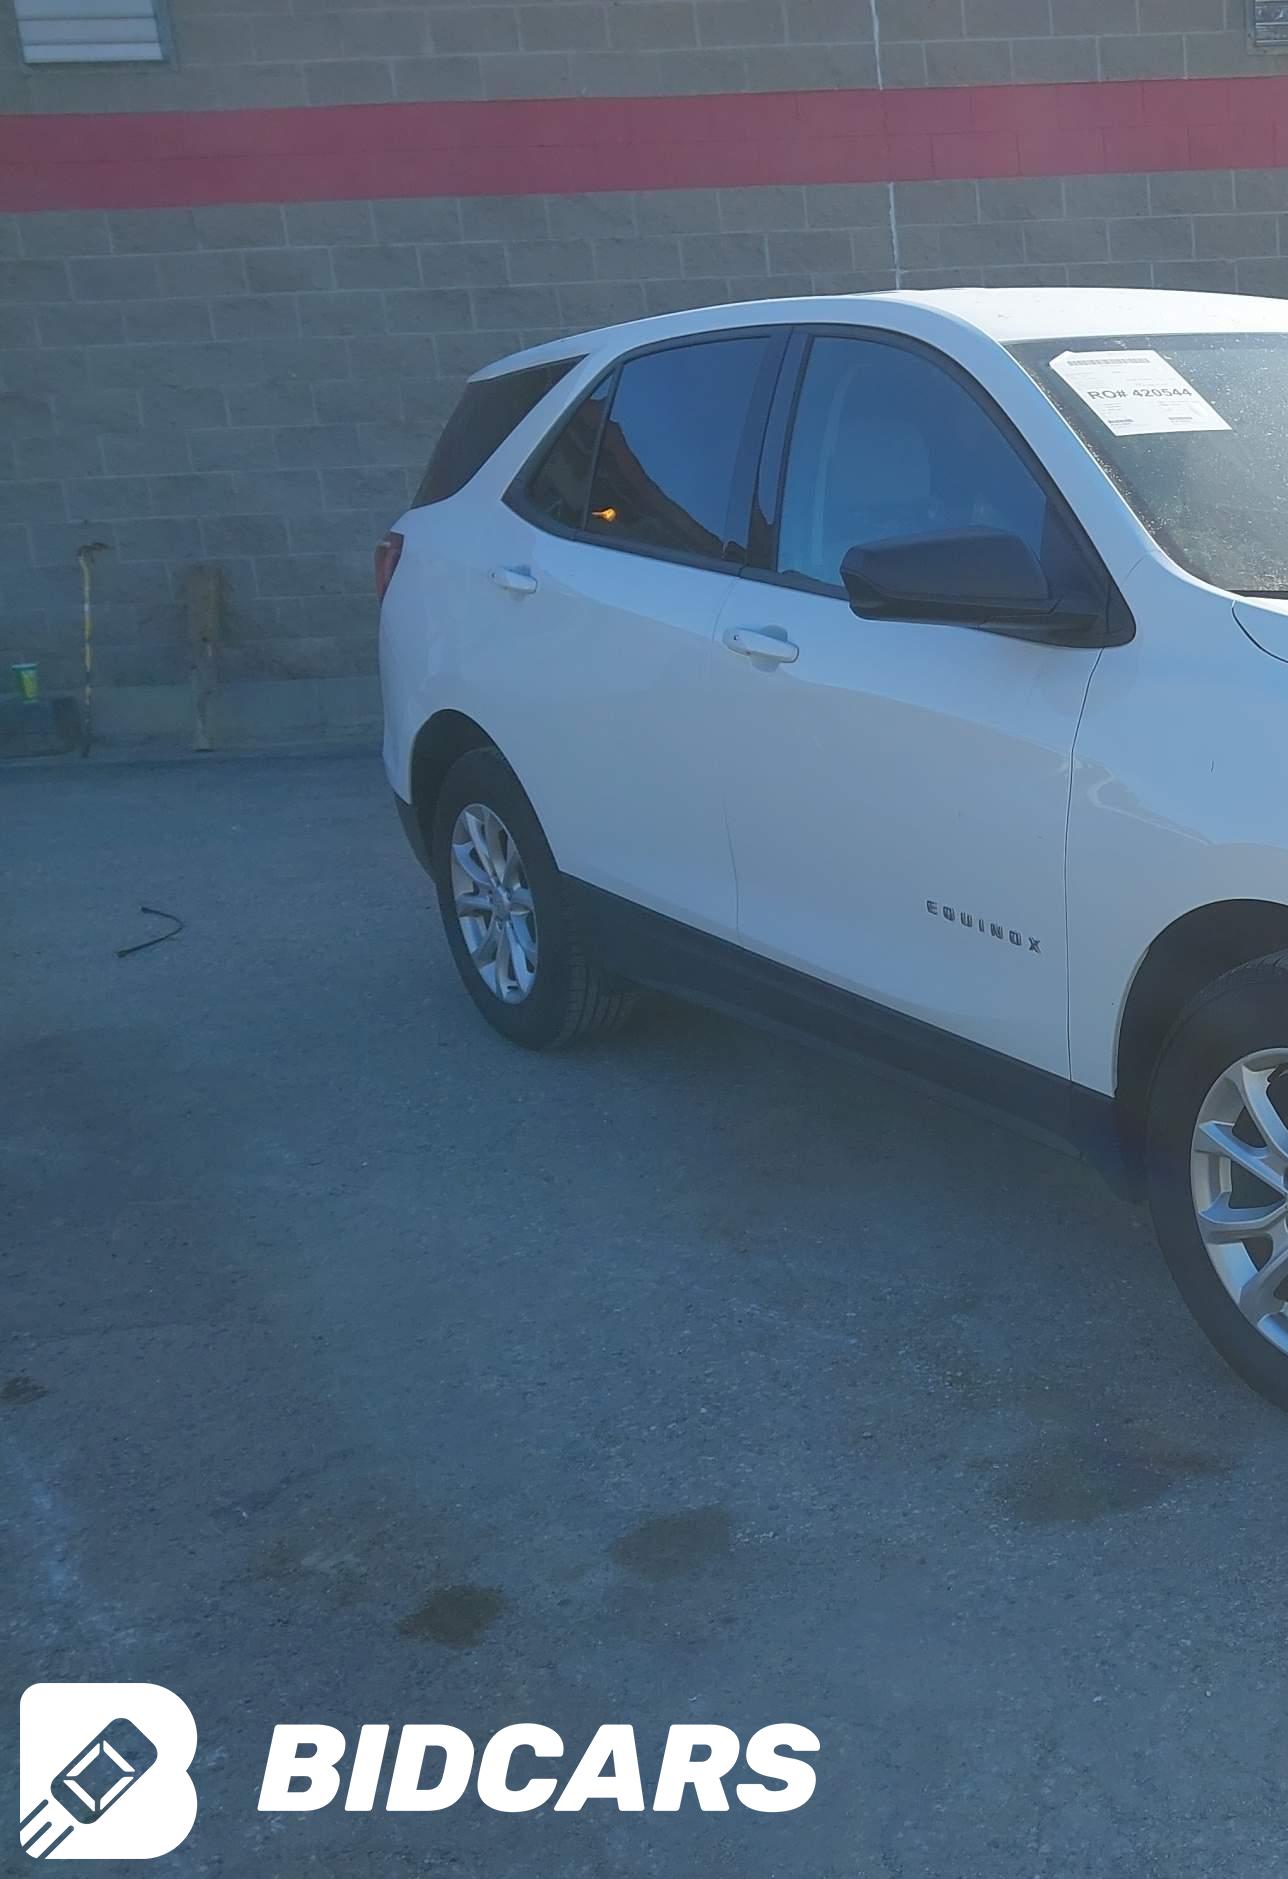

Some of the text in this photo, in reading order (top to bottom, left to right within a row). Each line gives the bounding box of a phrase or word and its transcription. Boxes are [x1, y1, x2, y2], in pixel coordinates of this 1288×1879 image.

[1086, 387, 1193, 400] RO# 420544
[926, 900, 1041, 954] EQUINOX
